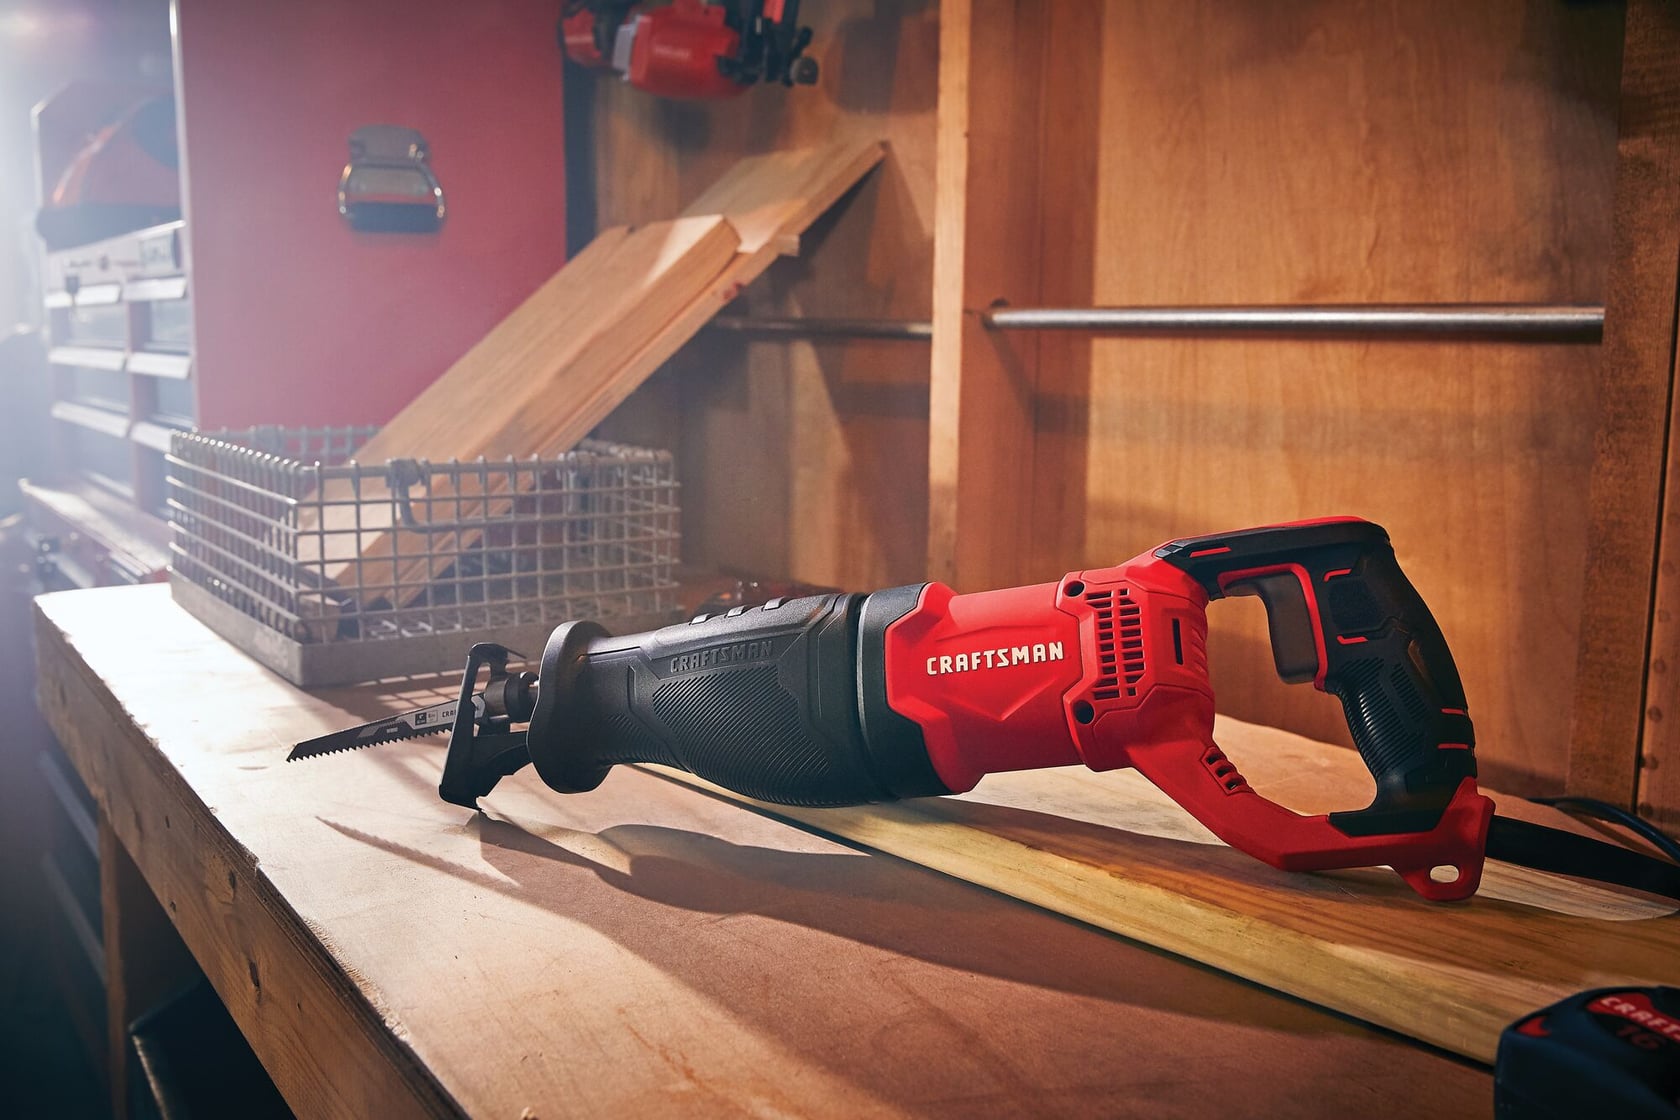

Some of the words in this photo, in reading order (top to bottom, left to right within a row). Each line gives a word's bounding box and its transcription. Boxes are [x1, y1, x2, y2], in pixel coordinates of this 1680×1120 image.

[671, 641, 772, 673] CRAFTSMAN
[926, 641, 1064, 676] CRAFTSMAN
[1600, 996, 1680, 1041] CRAFT
